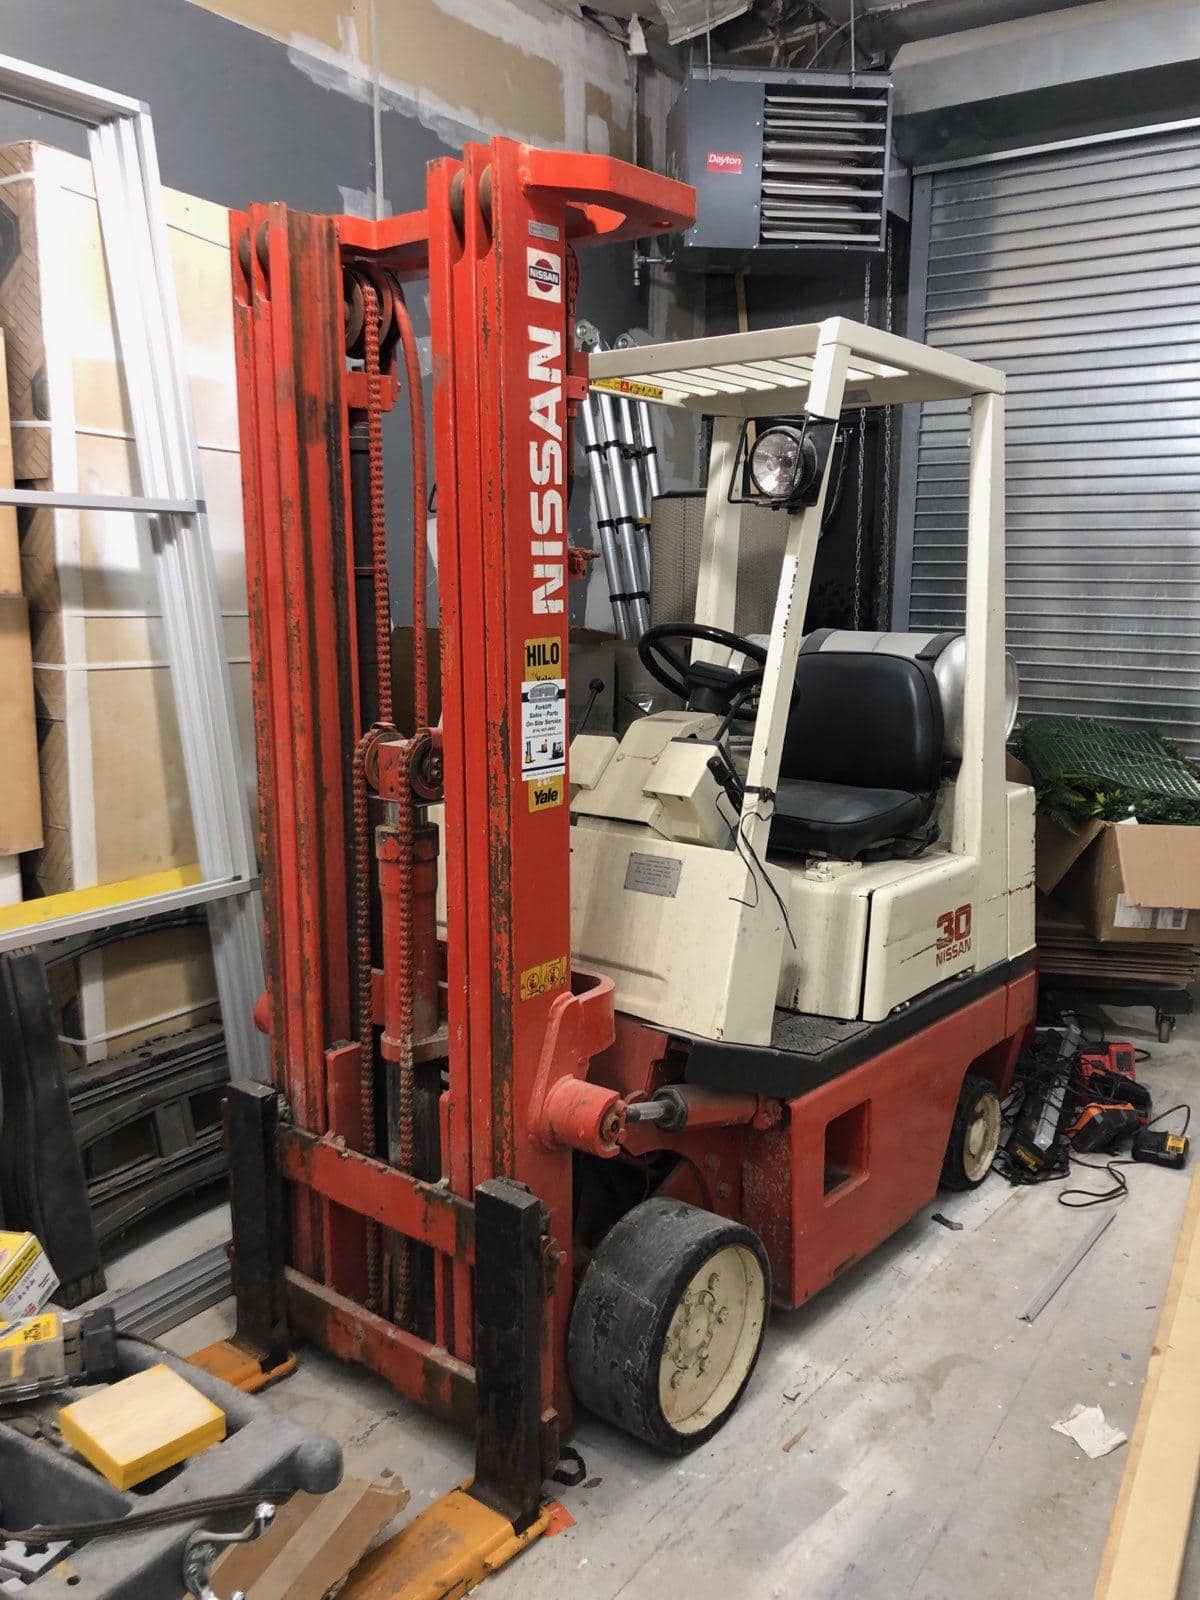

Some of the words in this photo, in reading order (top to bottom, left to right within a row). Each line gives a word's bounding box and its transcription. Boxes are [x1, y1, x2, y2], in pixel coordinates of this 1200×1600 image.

[708, 153, 742, 166] Dayton
[530, 268, 559, 283] NISSAN
[528, 325, 564, 614] NISSAN
[526, 643, 560, 667] HILO
[534, 788, 558, 805] Yale
[937, 903, 971, 950] 30
[936, 938, 971, 967] NISSAN
